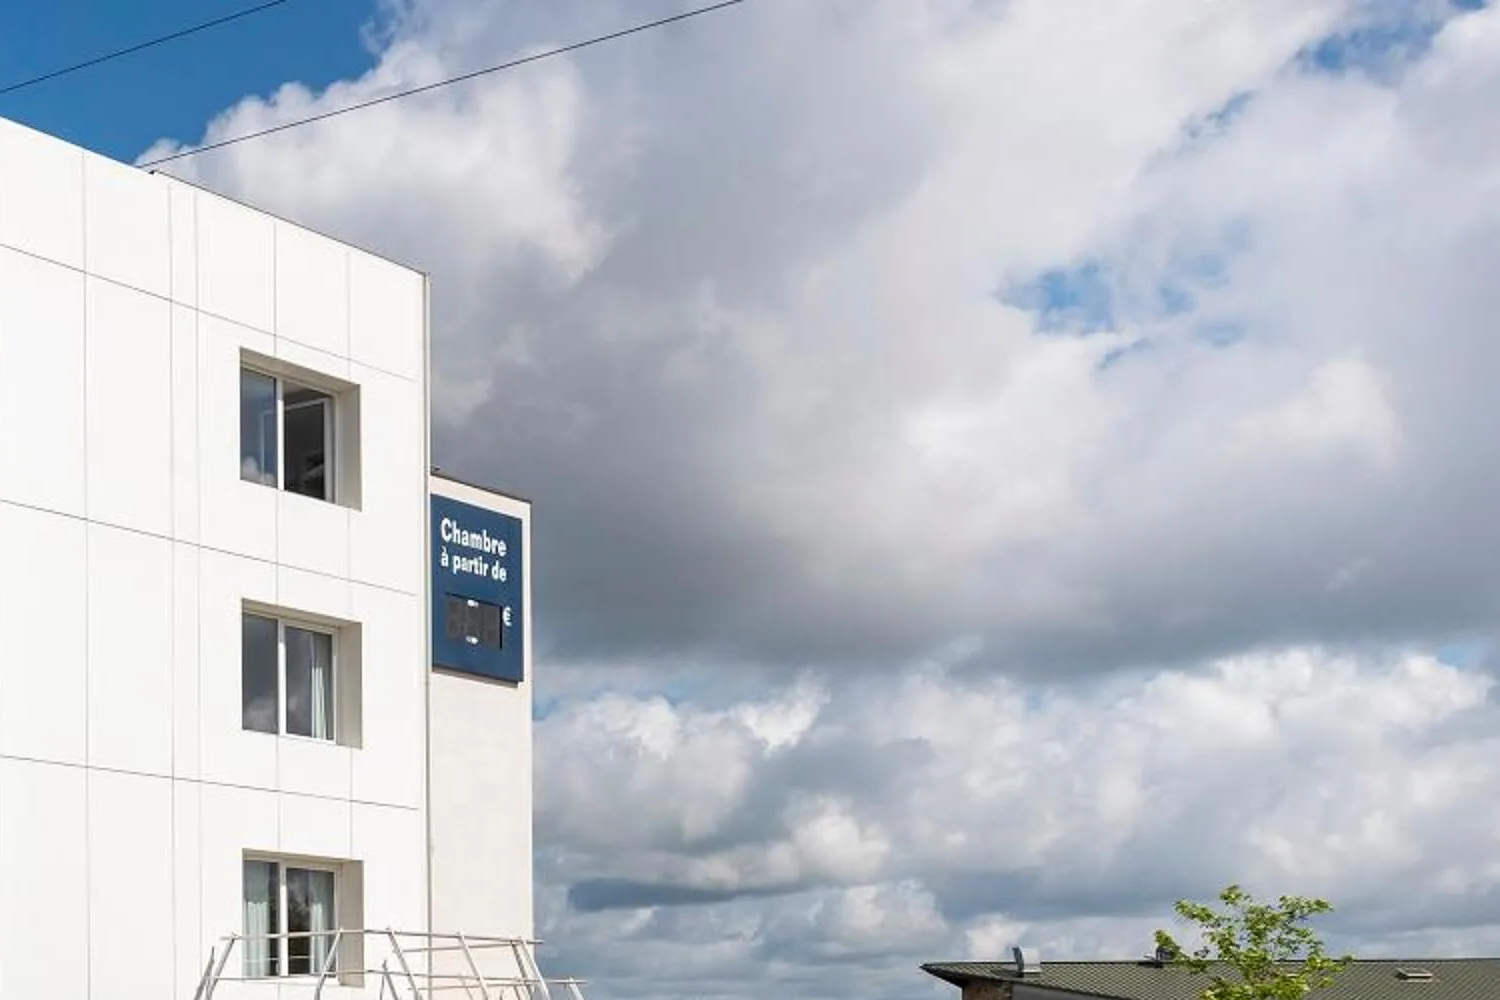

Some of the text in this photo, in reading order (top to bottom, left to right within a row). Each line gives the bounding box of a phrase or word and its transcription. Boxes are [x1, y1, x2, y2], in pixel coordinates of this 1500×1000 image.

[441, 518, 507, 557] Chambre
[441, 546, 507, 582] à partir de
[503, 606, 512, 627] €
